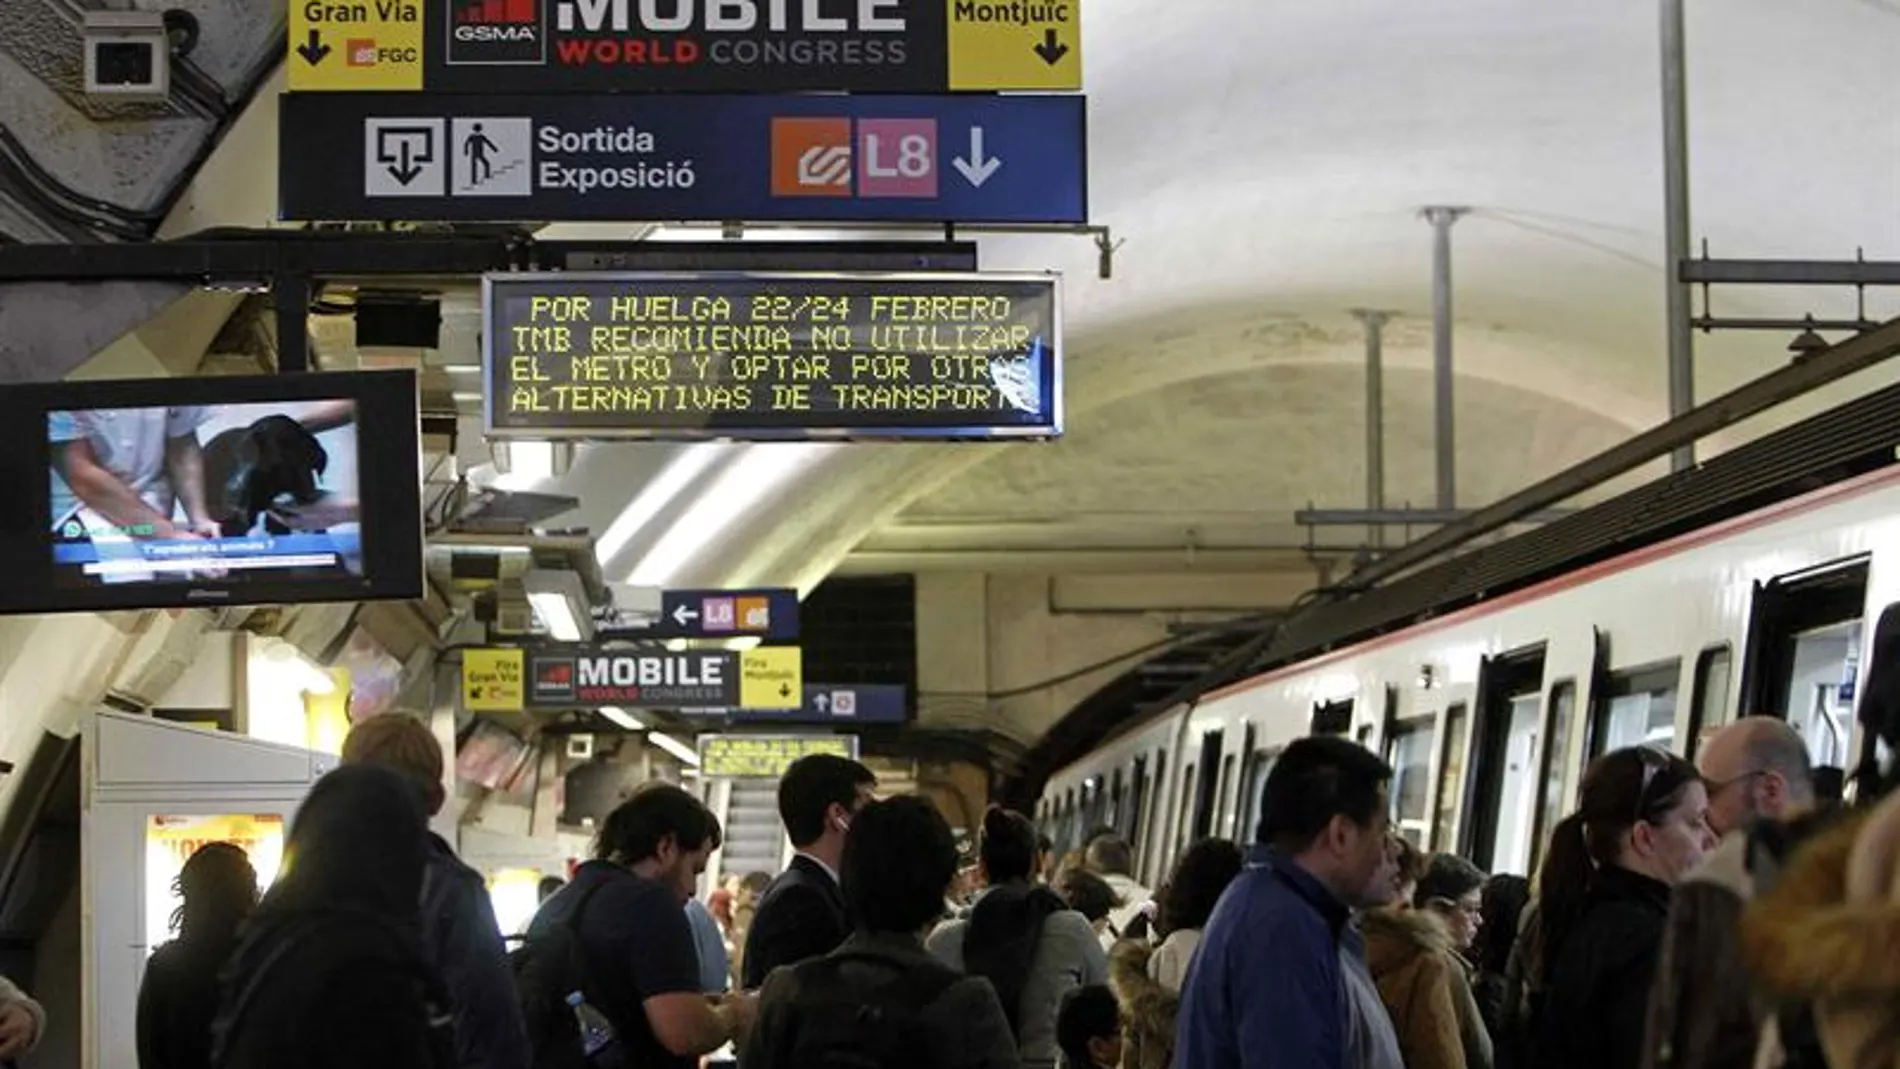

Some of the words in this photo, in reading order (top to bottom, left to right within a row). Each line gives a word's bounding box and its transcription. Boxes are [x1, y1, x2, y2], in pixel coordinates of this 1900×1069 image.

[305, 1, 366, 23] Gran
[455, 26, 536, 41] GSMA
[377, 48, 418, 63] FGC
[557, 40, 699, 64] WORLD
[710, 40, 907, 64] CONGRESS
[538, 126, 655, 154] Sortida
[865, 133, 931, 178] L8
[538, 158, 696, 193] Exposició
[531, 296, 592, 322] POR
[611, 296, 731, 321] HUELGA
[751, 296, 851, 321] 22/24
[870, 296, 1011, 321] FEBRERO
[512, 326, 572, 352] TMB
[591, 326, 792, 352] RECOMIENDA
[811, 325, 851, 351] NO
[870, 325, 1030, 351] UTILIZAR
[511, 356, 551, 381] EL
[571, 356, 671, 381] METRO
[691, 356, 711, 381] Y
[731, 355, 831, 380] OPTAR
[851, 355, 911, 380] POR
[511, 385, 752, 412] ALTERNATIVAS
[771, 384, 811, 410] DE
[831, 384, 1027, 411] TRANSPORT
[704, 604, 733, 624] L8
[577, 657, 723, 685] MOBILE
